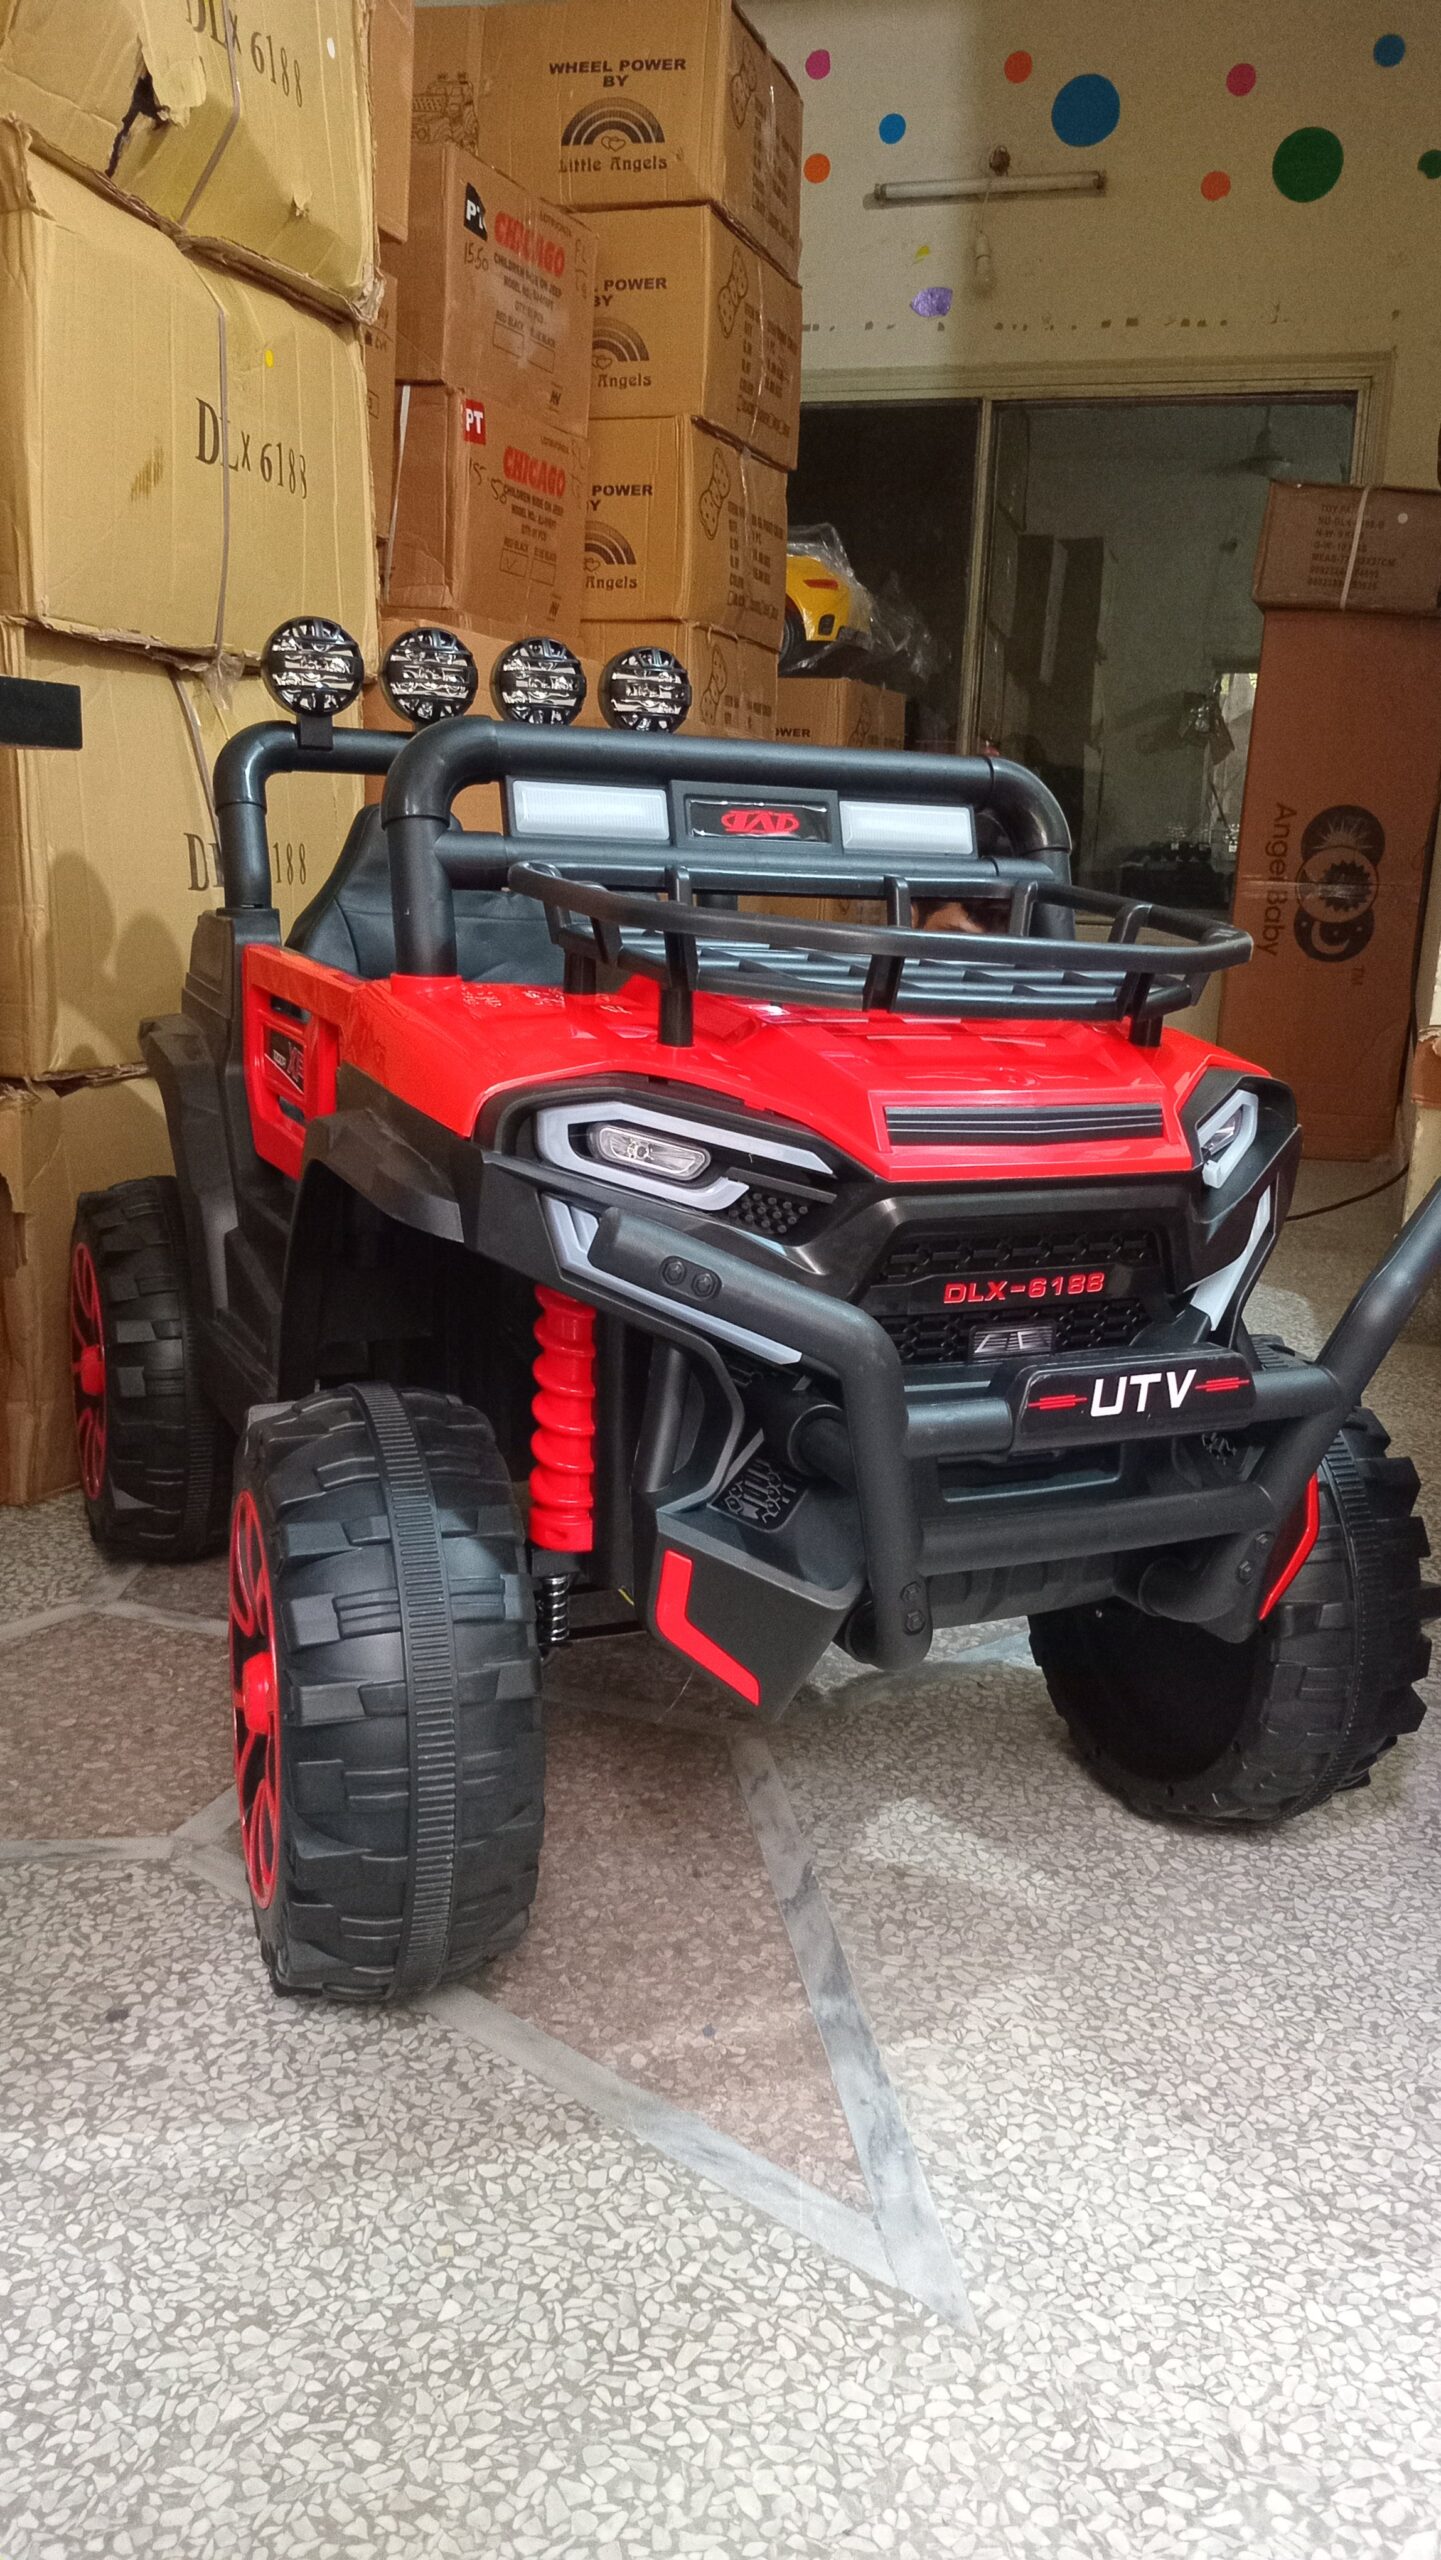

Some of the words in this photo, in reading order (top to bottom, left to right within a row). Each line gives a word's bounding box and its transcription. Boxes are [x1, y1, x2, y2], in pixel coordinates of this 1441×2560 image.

[251, 32, 303, 108] 6188
[550, 61, 613, 75] WHEEL
[619, 58, 686, 72] POWER
[603, 75, 629, 88] BY
[559, 158, 602, 174] Little
[610, 156, 668, 173] Angels
[603, 278, 667, 291] POWER
[598, 373, 652, 389] Angels
[465, 408, 484, 434] PT
[260, 442, 308, 499] 6188
[503, 446, 566, 498] CHICAGO
[592, 485, 653, 496] POWER
[585, 576, 637, 591] Angels
[775, 727, 811, 738] WER
[1257, 890, 1288, 957] Baby
[943, 1272, 1105, 1304] DLX-6188
[1090, 1369, 1197, 1417] UTV
